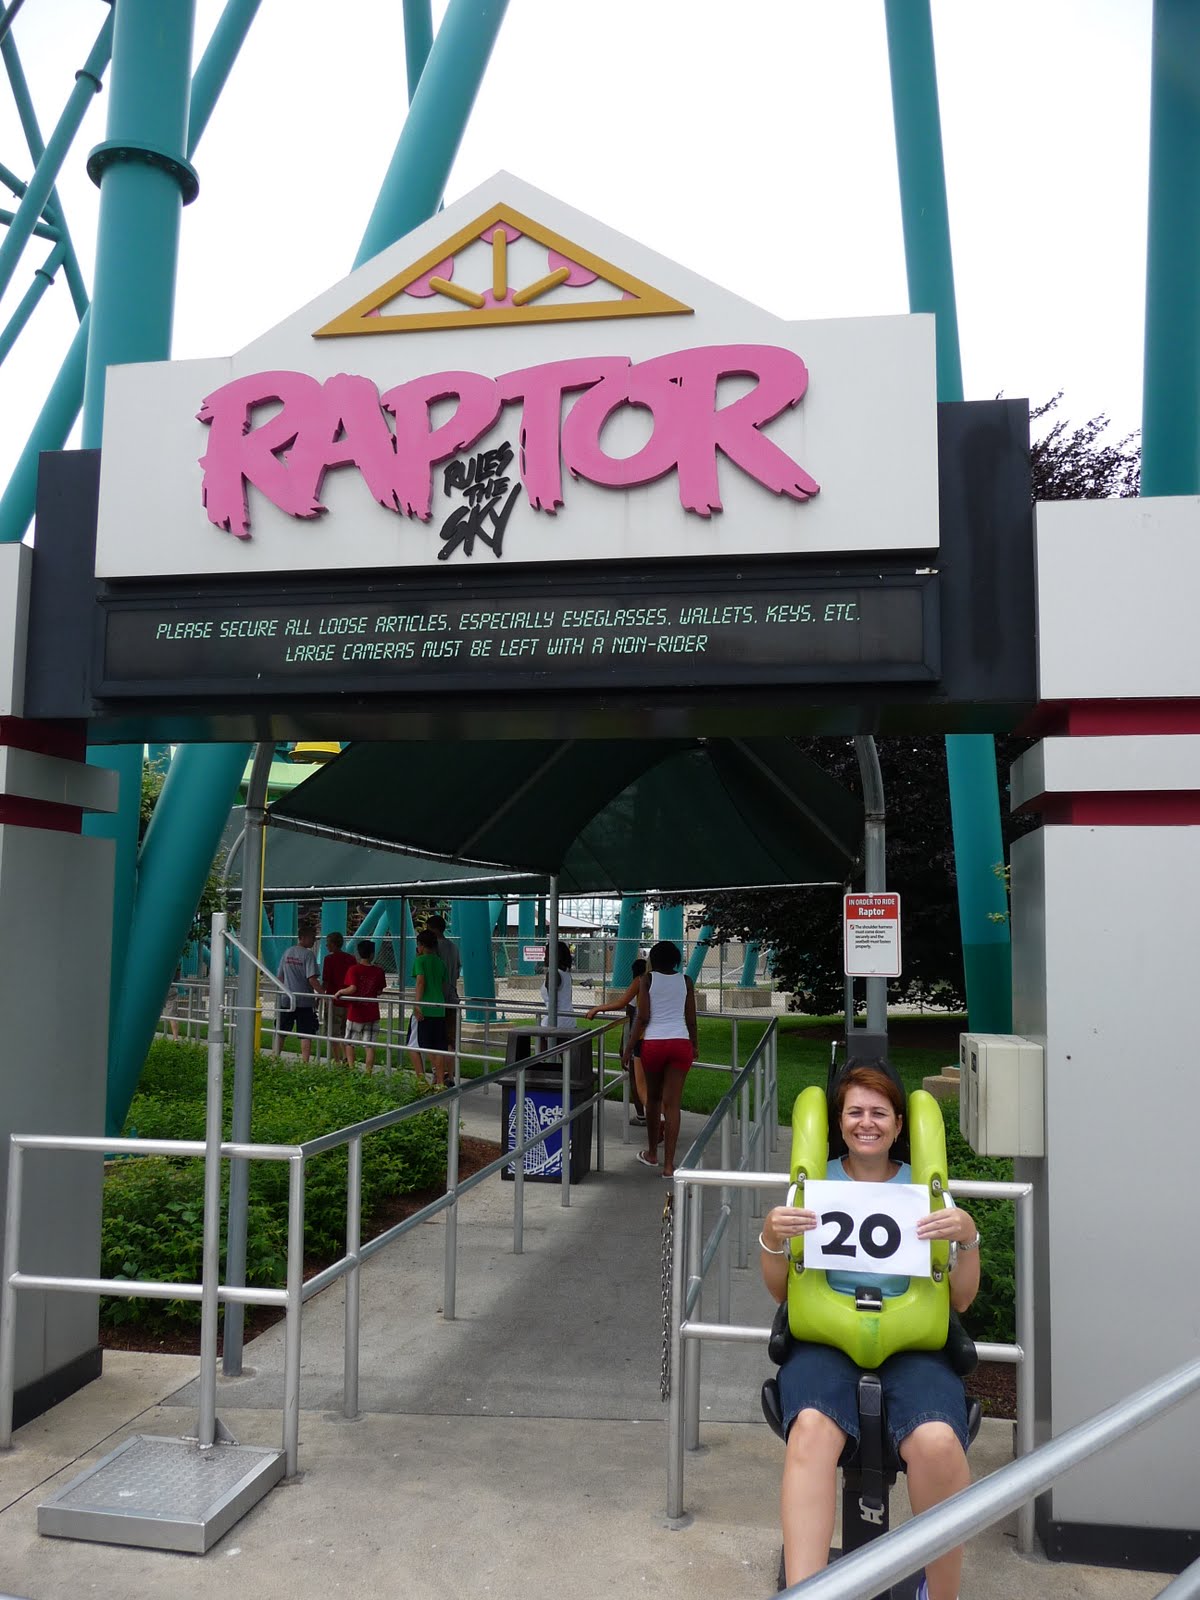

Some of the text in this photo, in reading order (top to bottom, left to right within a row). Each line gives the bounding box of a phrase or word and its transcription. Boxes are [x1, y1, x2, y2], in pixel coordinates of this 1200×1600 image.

[195, 344, 820, 543] RAPTOR
[443, 440, 514, 498] RULES
[462, 476, 510, 507] THE
[437, 482, 522, 561] SKY
[156, 622, 213, 640] PLEASE
[219, 620, 279, 638] SECURE
[285, 618, 312, 636] ALL
[318, 617, 369, 635] LOOSE
[458, 611, 555, 630] ESPECIALLY
[823, 603, 861, 621] ETC.
[285, 634, 709, 662] LARGE CAMERAS MUST BE LEFT WITH A NON-RIDER
[858, 907, 885, 917] Raptor
[820, 1210, 902, 1259] 20
